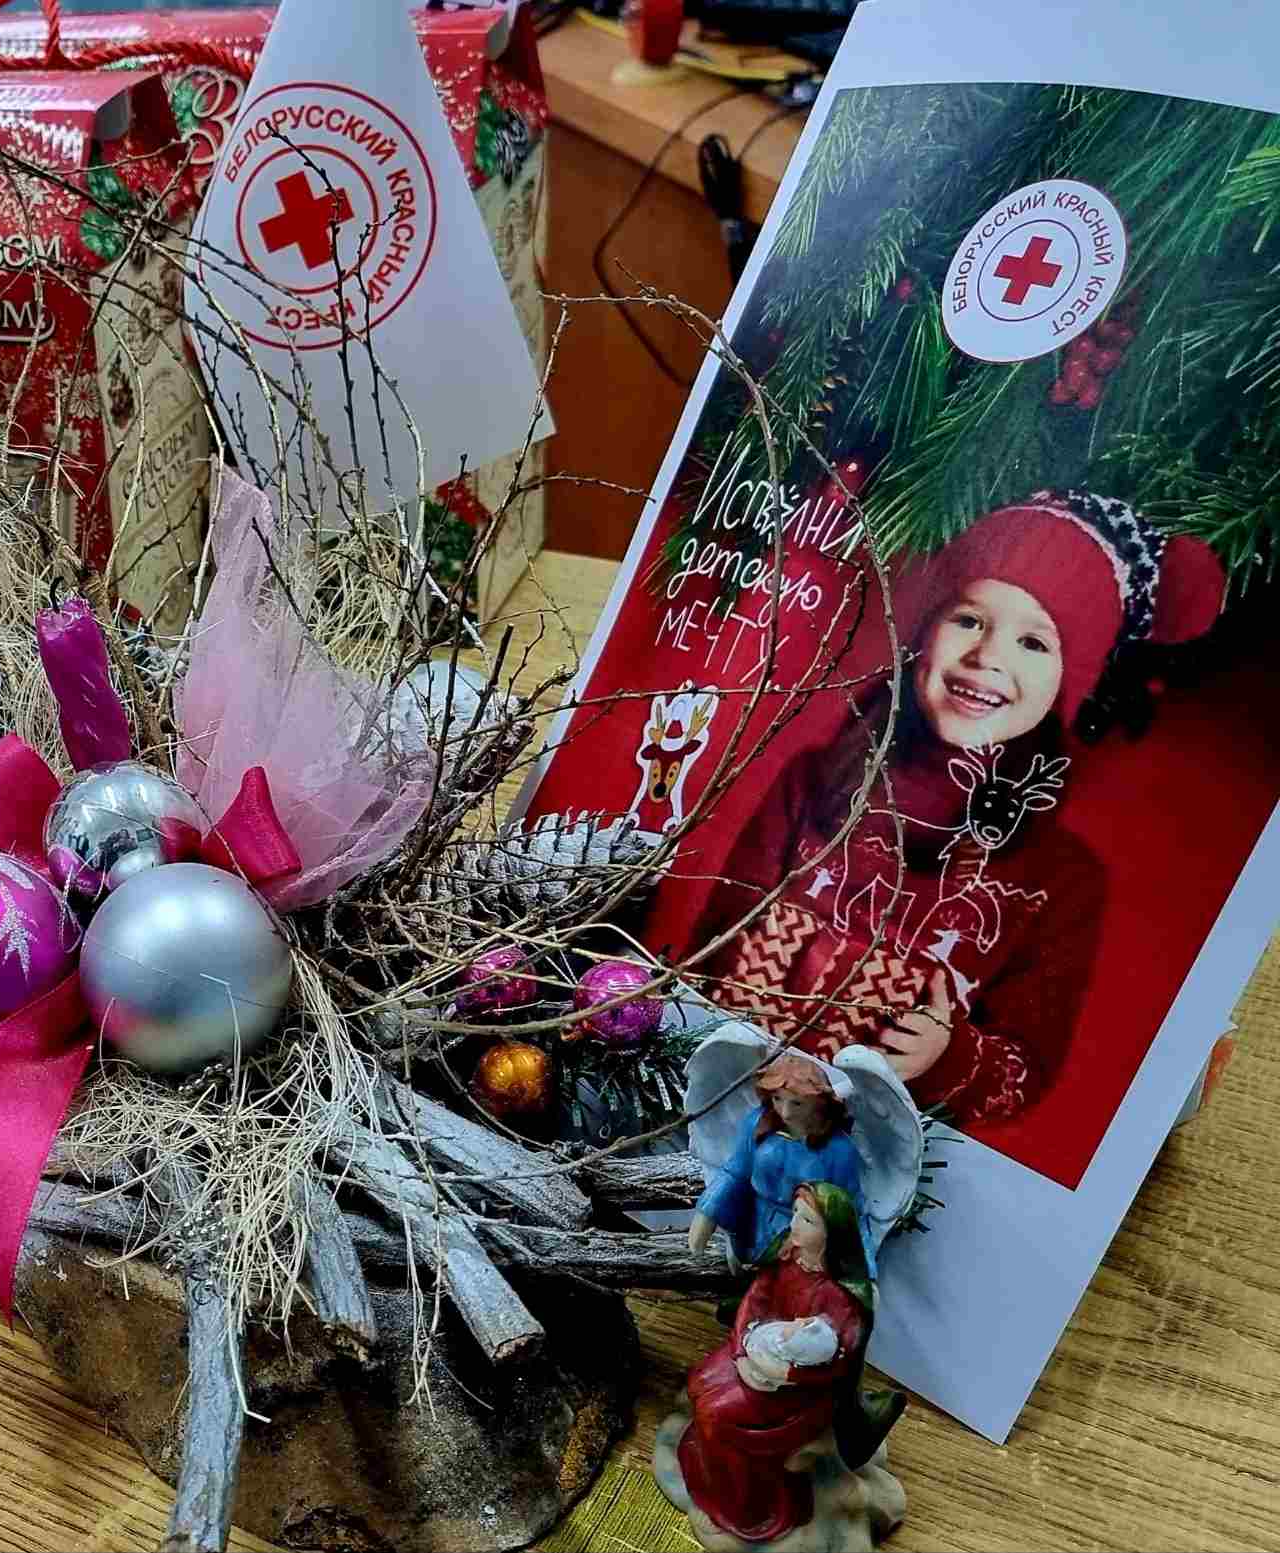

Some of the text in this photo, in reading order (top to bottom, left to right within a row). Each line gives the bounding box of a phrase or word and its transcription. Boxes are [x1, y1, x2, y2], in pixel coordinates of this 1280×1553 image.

[224, 105, 396, 184] БЕЛОРУССКИЙ
[366, 168, 417, 305] КРАСНЫЙ
[952, 190, 1114, 336] БЕЛОРУССКИЙ КРАСНЫЙ КРЕСТ
